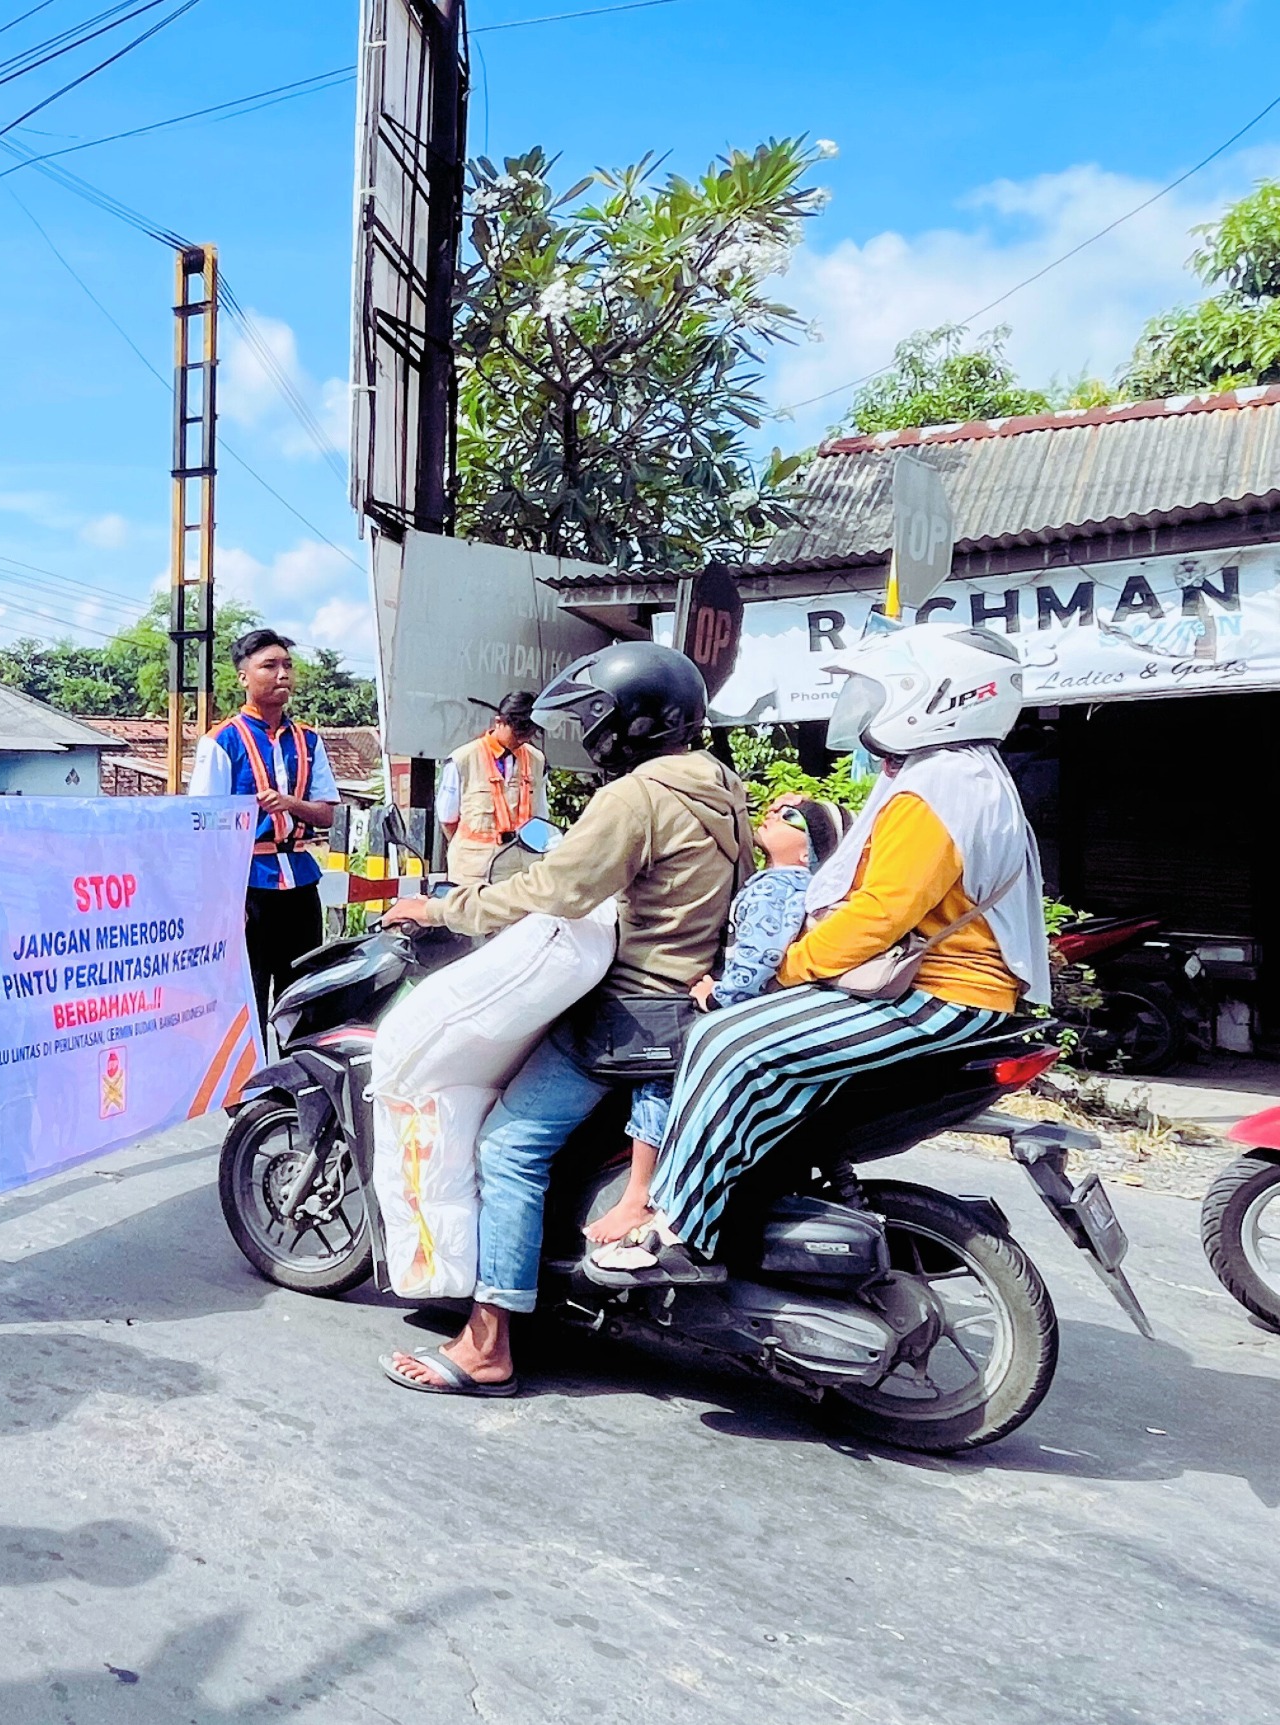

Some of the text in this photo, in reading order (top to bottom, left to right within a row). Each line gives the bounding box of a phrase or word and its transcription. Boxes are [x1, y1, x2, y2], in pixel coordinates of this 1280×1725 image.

[896, 504, 948, 566] TOP
[693, 606, 732, 666] OP
[1036, 671, 1127, 690] Ladies
[1139, 662, 1158, 679] &
[791, 690, 839, 702] Phone
[938, 681, 998, 714] JPR
[73, 873, 137, 912] STOP
[13, 917, 185, 961] JANGAN MENEROBOS
[4, 968, 58, 1000] PINTU
[64, 953, 170, 990] PERLINTASAN
[172, 945, 210, 973] KERETA
[212, 939, 227, 963] API
[11, 1043, 41, 1064] LINTAS
[43, 1042, 52, 1056] DI
[54, 1030, 105, 1054] PERLINTASAN,
